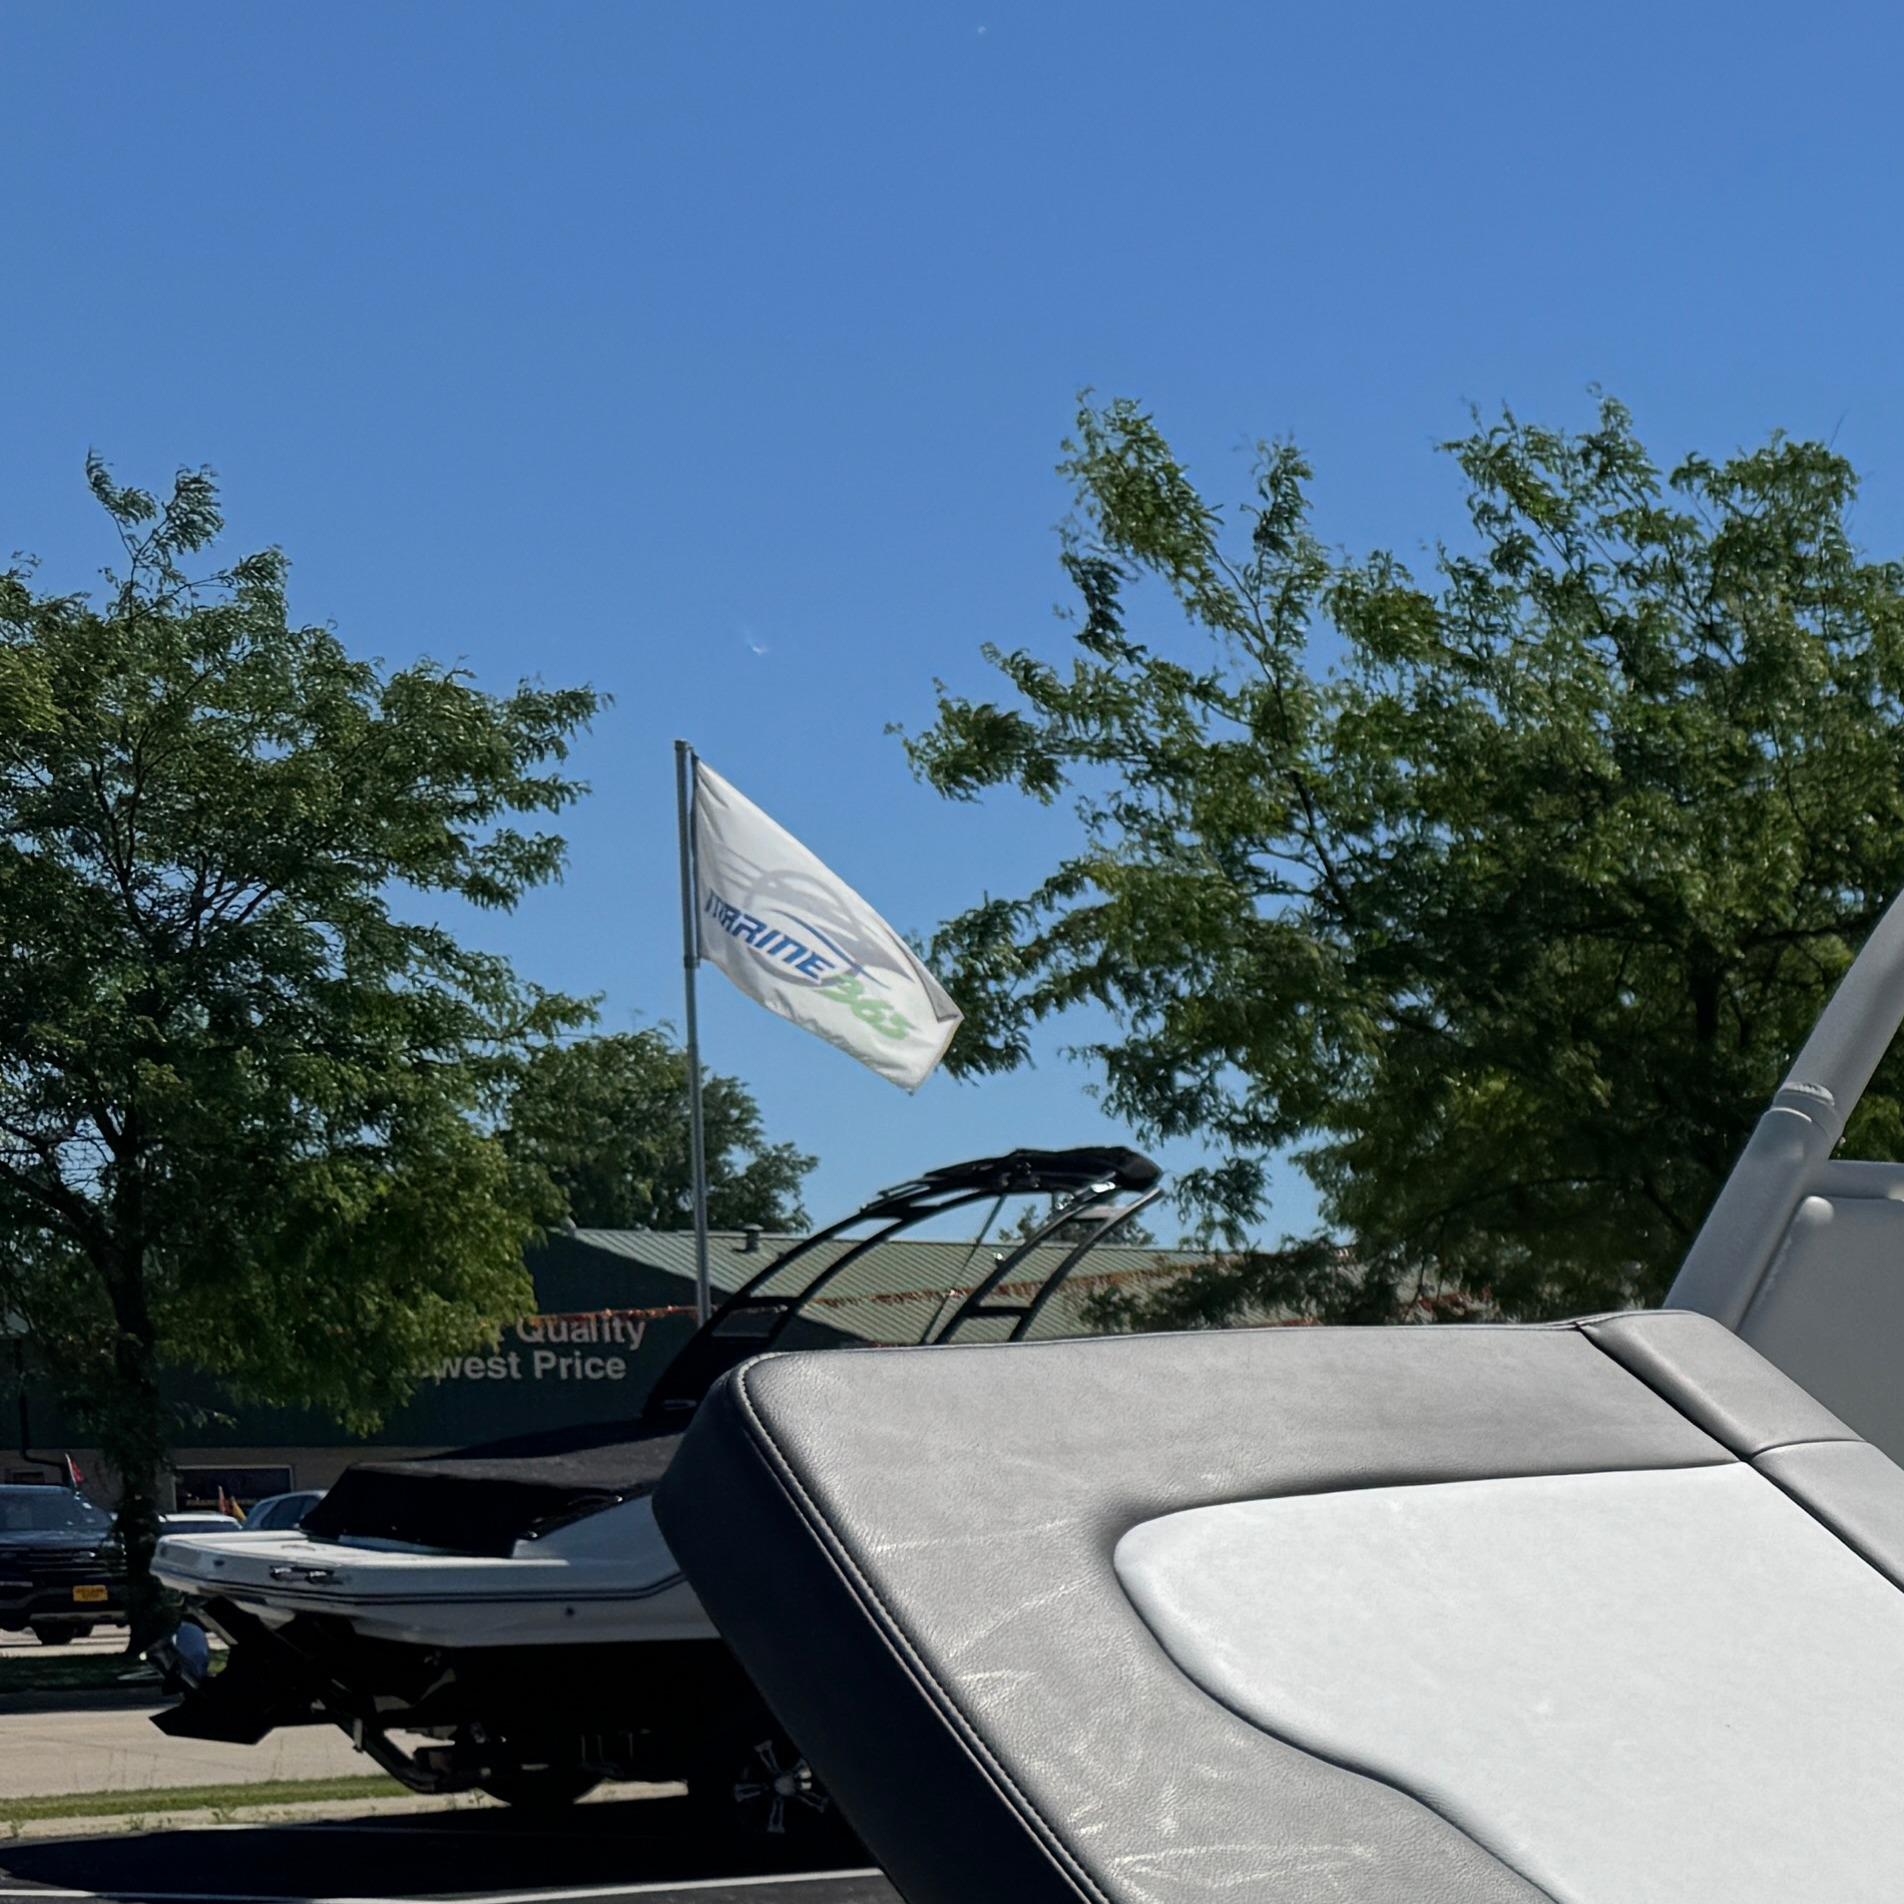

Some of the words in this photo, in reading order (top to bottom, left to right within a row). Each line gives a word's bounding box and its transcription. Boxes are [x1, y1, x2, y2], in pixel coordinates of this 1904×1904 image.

[516, 1314, 646, 1351] Quality
[423, 1351, 522, 1381] west
[533, 1351, 627, 1381] Price
